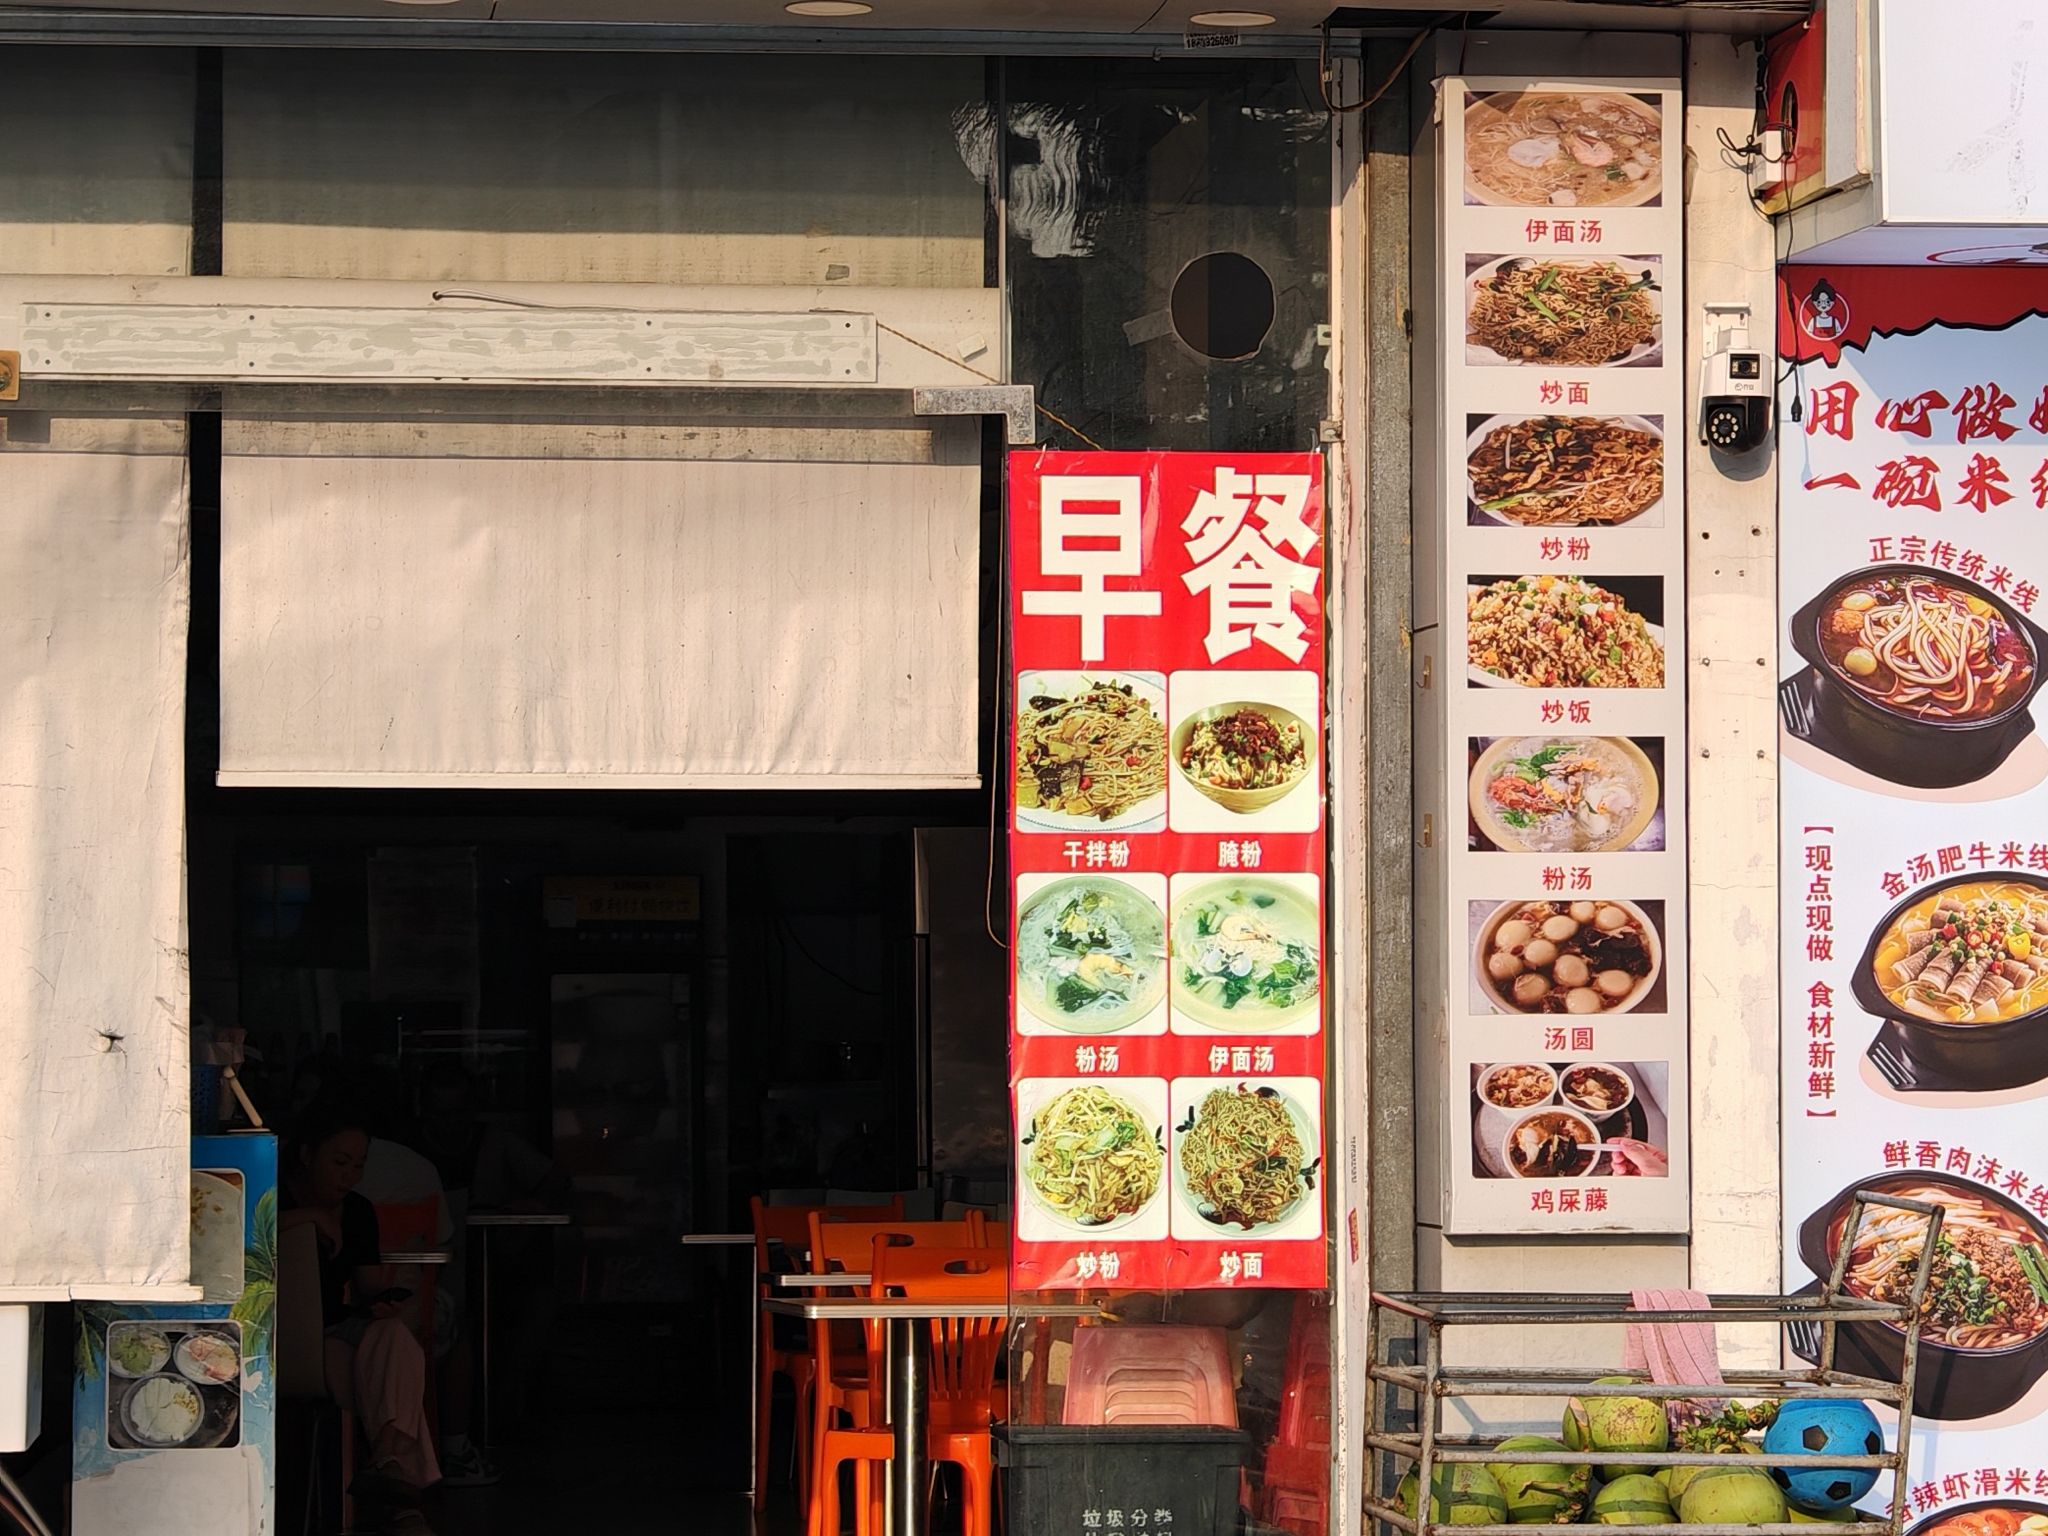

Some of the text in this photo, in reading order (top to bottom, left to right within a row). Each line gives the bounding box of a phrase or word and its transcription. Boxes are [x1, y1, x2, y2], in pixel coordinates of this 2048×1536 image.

[1525, 219, 1602, 243] 伊面汤
[1540, 380, 1590, 405] 炒面
[1540, 537, 1591, 561] 炒粉
[1022, 467, 1321, 665] 早餐
[1869, 535, 2040, 614] 正宗传统米线
[1541, 700, 1592, 724] 炒饭
[1062, 840, 1130, 868] 干拌粉
[1217, 840, 1262, 868] 腌粉
[1541, 866, 1593, 891] 粉汤
[1880, 841, 2048, 900] 金汤肥牛米线
[1544, 1027, 1594, 1051] 汤圆
[1075, 1045, 1120, 1073] 粉汤
[1208, 1045, 1275, 1073] 伊面汤
[1883, 1139, 2048, 1219] 鲜香肉沫米线
[1530, 1187, 1609, 1214] 鸡屎藤
[1076, 1251, 1120, 1279] 炒粉
[1220, 1251, 1264, 1278] 炒面
